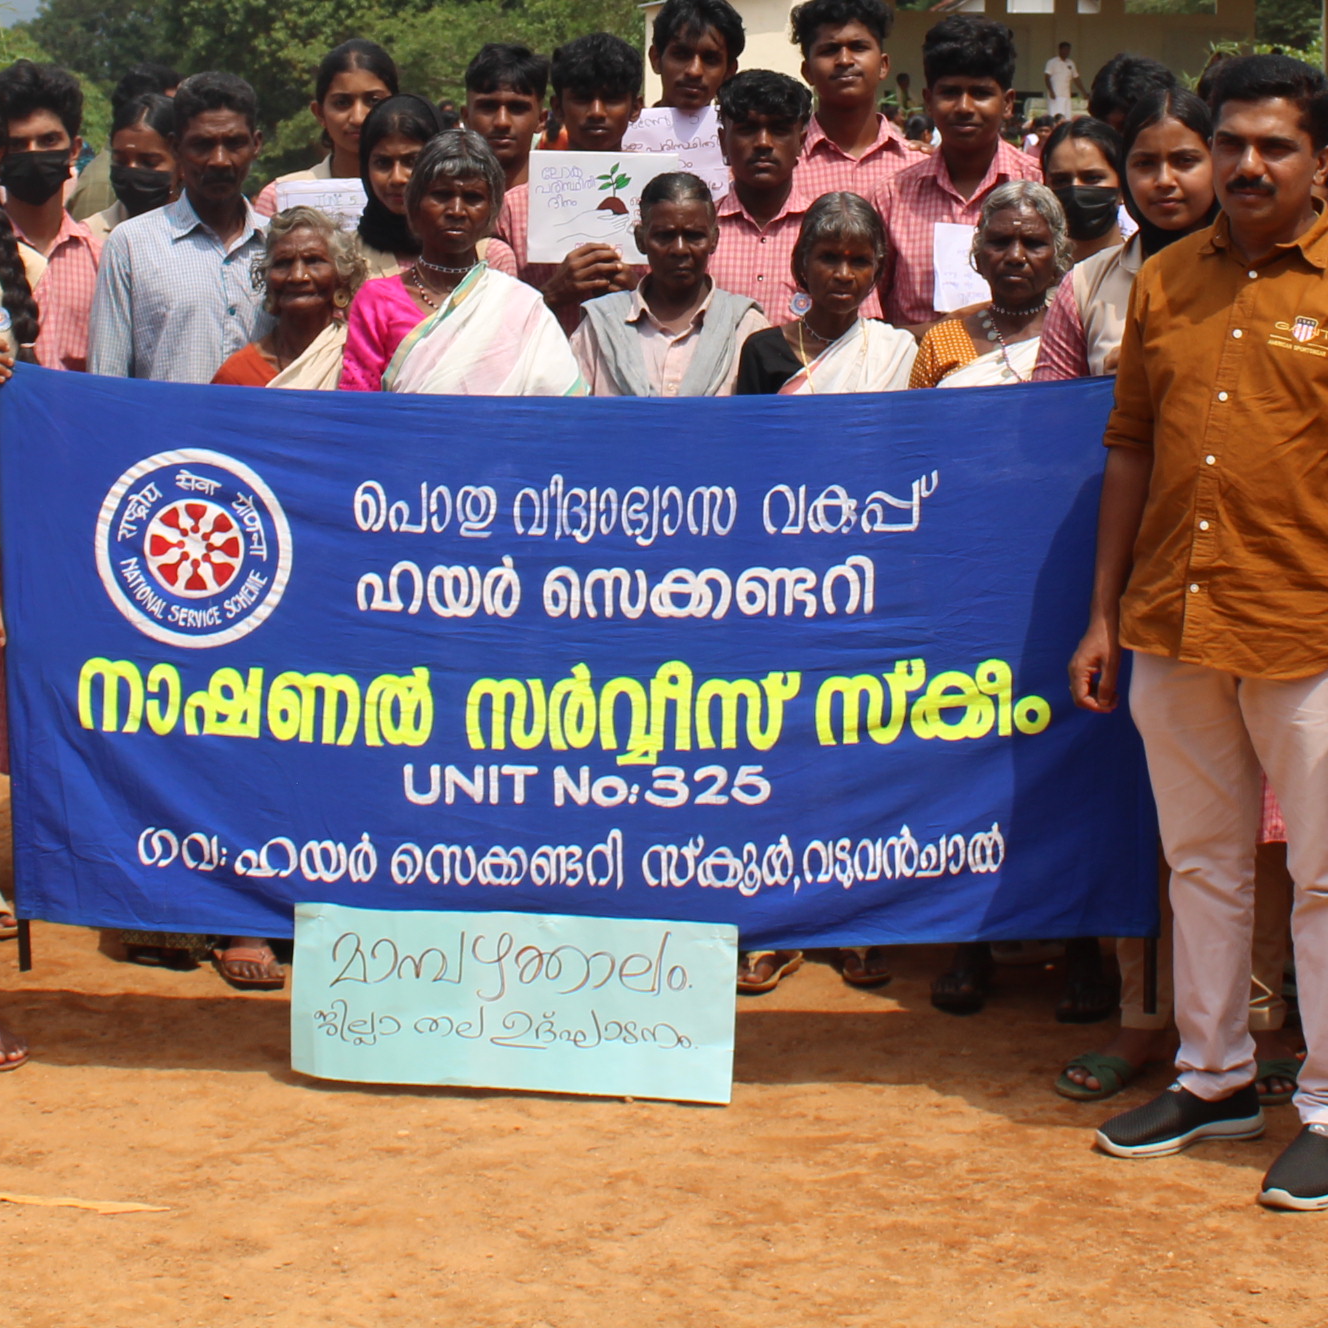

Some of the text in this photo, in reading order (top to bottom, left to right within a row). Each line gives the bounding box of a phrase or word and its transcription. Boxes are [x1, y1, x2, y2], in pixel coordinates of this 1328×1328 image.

[175, 469, 222, 496] सेवा
[353, 469, 939, 547] പൊതു വിദ്യാഭ്യാസ വകുപ്പ്
[120, 557, 268, 628] NATIONAL SERVICE SCHEME
[356, 553, 875, 620] ഹയർ സെക്കണ്ടറി
[77, 656, 1052, 766] നാഷണൽ സർവ്വീസ് സ്കീം
[403, 763, 539, 805] UNIT
[391, 828, 624, 890] സെക്കണ്ടറി
[414, 1005, 485, 1039] തല
